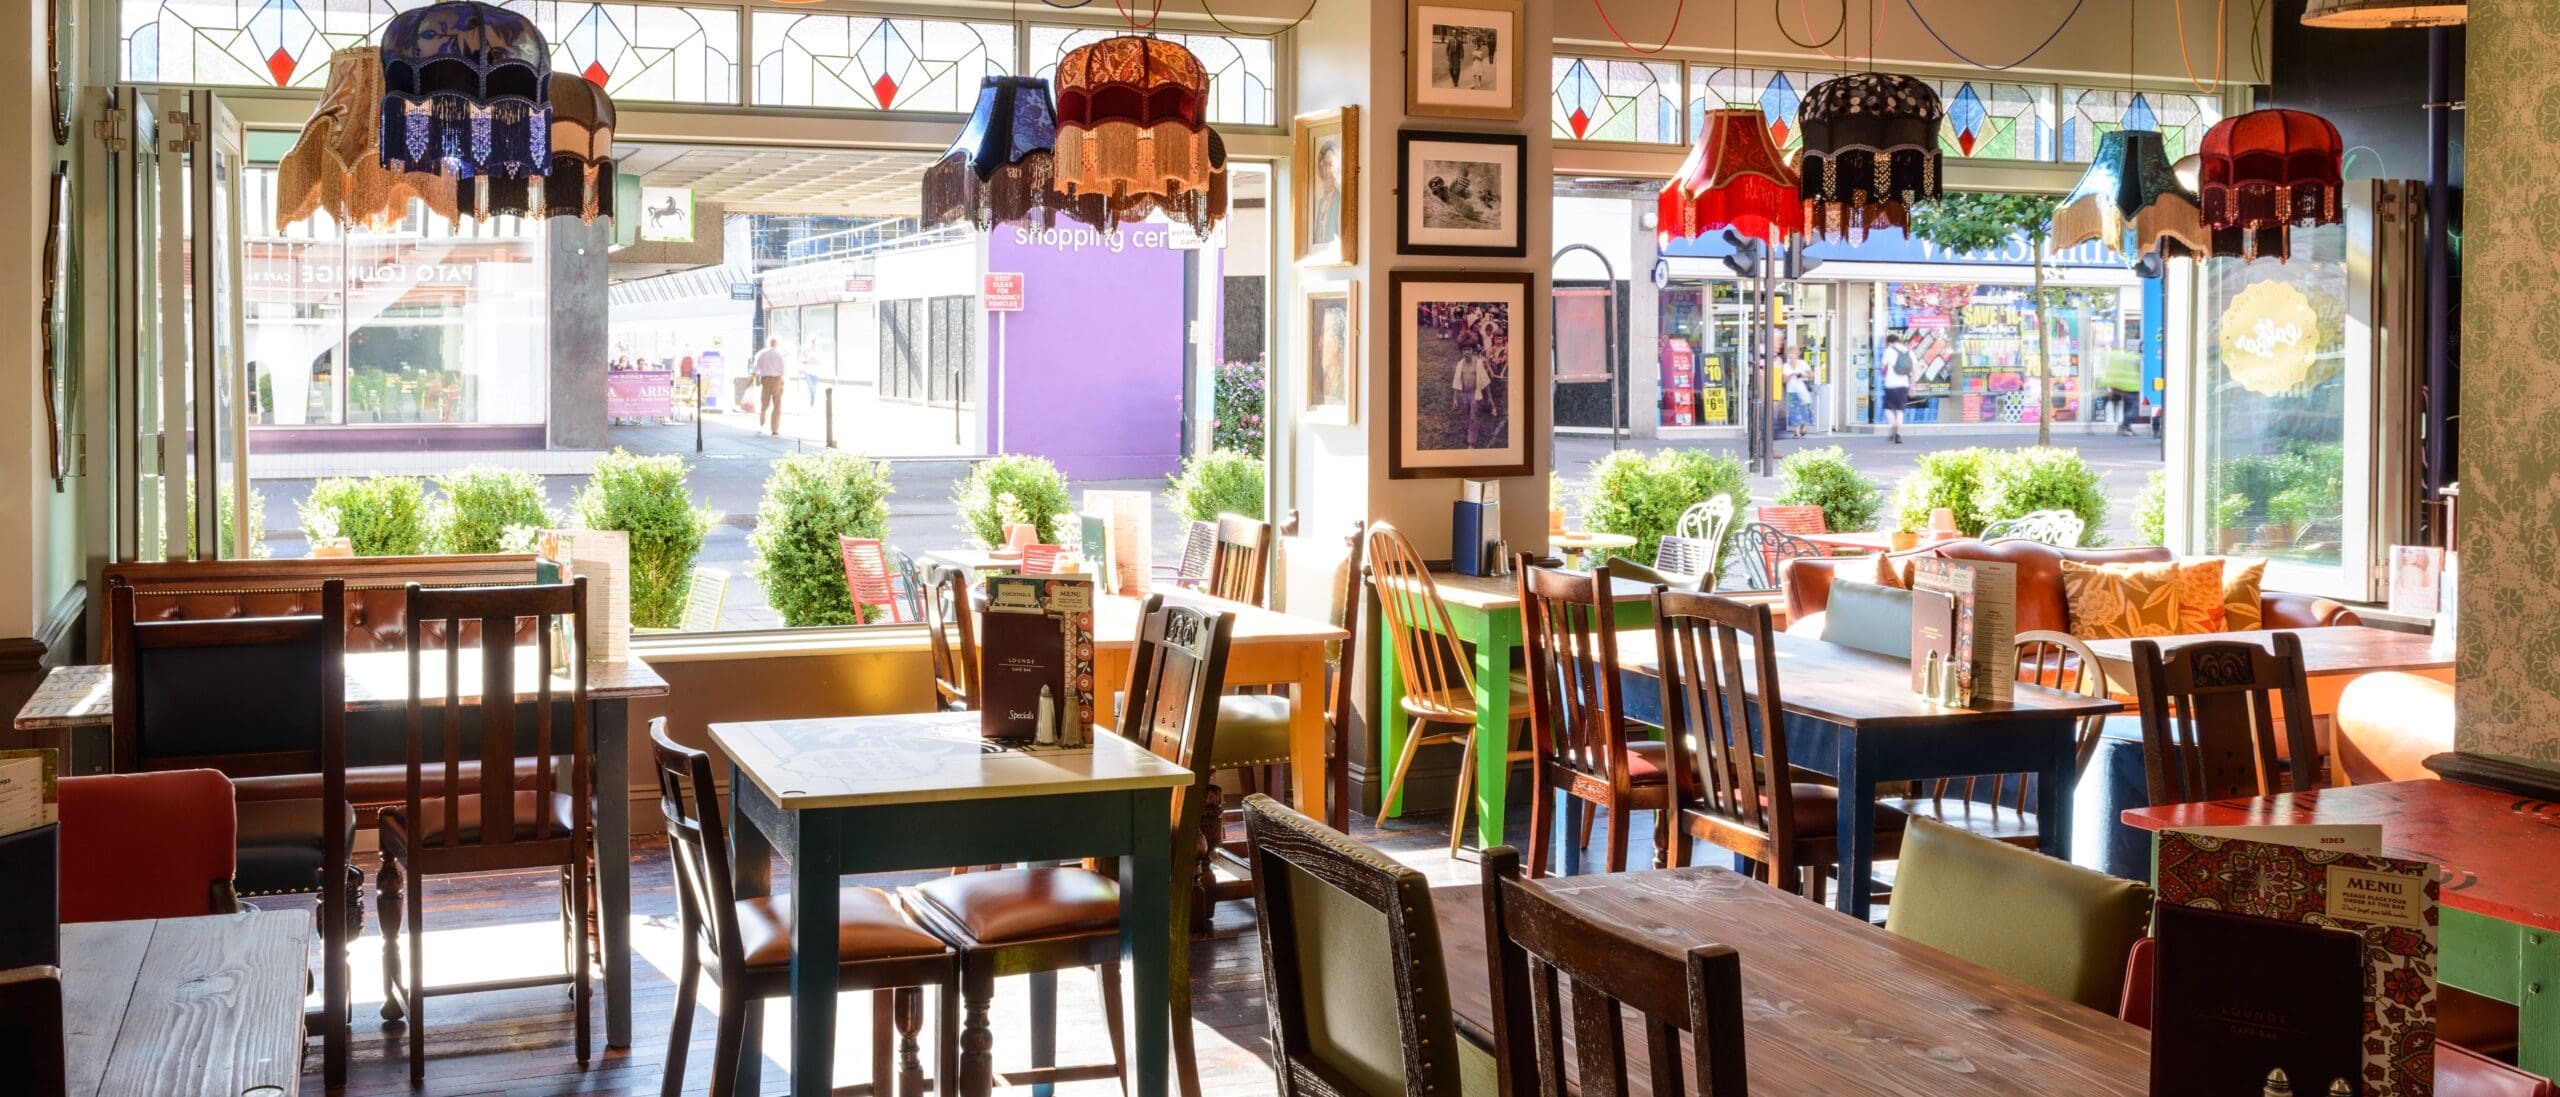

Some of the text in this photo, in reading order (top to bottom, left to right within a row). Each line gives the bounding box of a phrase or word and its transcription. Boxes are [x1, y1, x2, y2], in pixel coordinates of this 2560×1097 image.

[1008, 709, 1034, 720] Specials
[2346, 877, 2403, 895] MENU
[2387, 897, 2407, 905] YOUR
